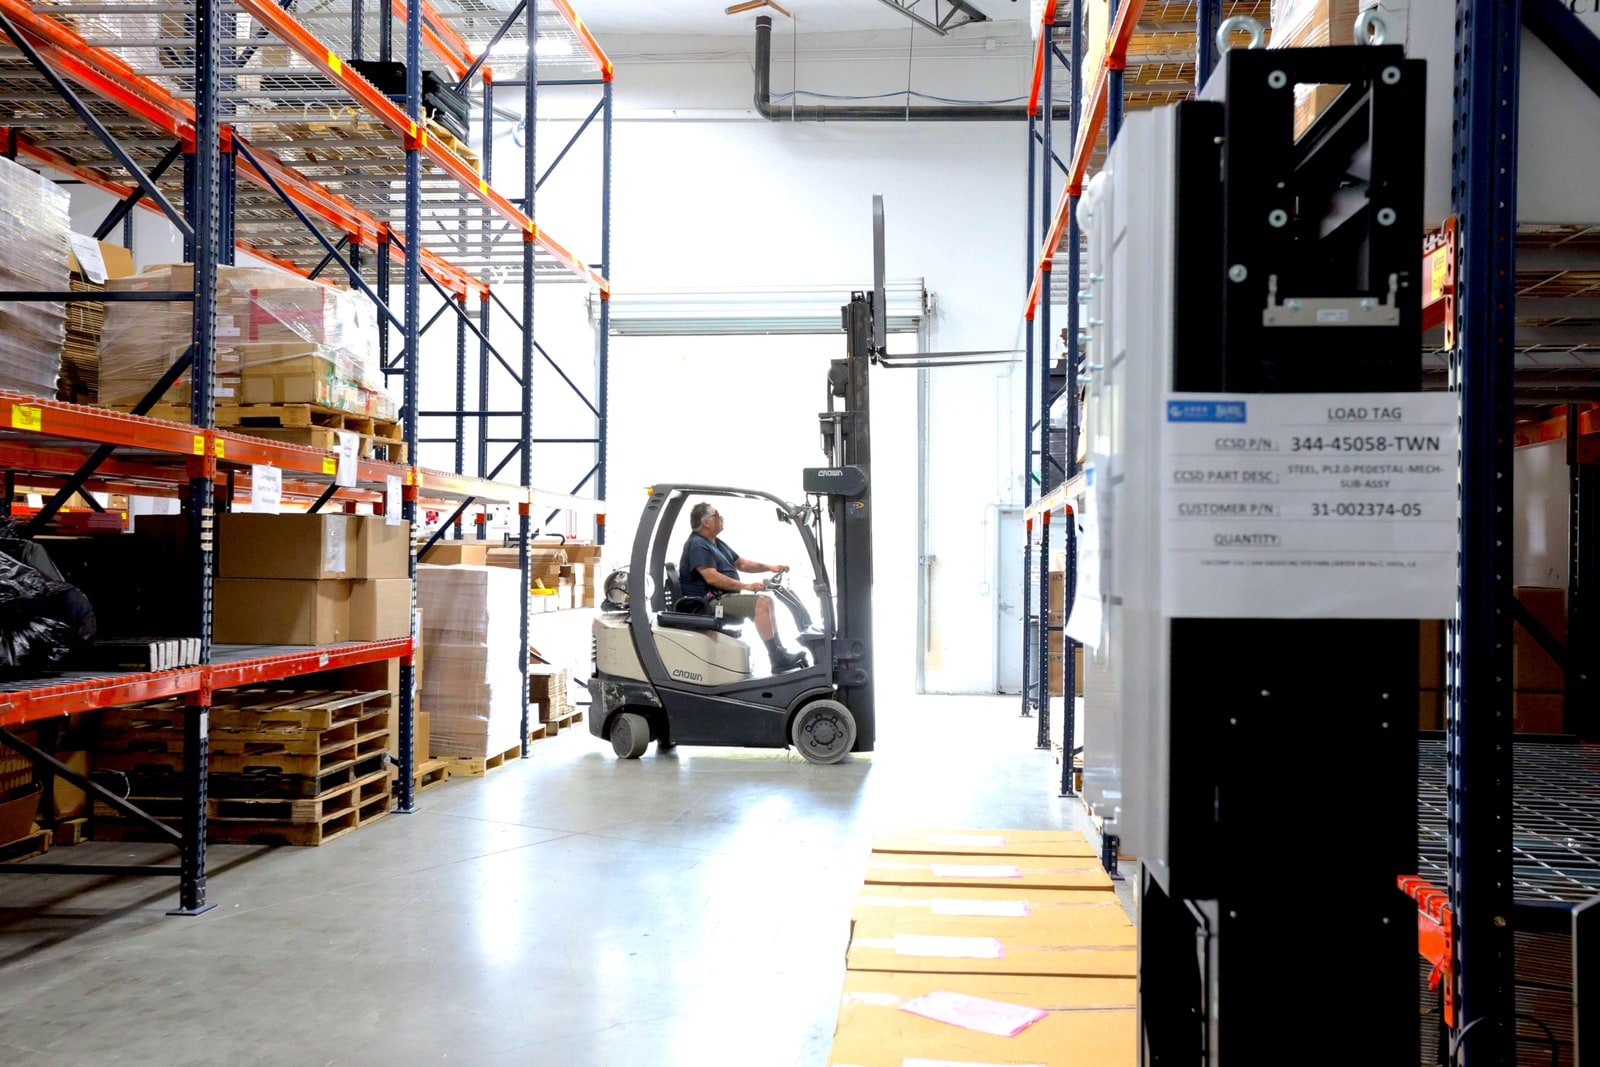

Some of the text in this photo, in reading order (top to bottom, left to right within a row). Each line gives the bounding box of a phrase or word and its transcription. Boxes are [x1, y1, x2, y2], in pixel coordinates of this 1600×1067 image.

[1328, 407, 1402, 419] LOAD TAG
[1215, 438, 1246, 450] CCSD
[1291, 436, 1440, 451] 344-45058-TWN
[1288, 464, 1319, 475] STEEL,
[1174, 470, 1205, 482] CCSD
[1207, 471, 1239, 481] PART
[1340, 479, 1391, 489] SUB-ASSY
[1178, 503, 1247, 514] CUSTOMER
[1312, 503, 1422, 516] 31-002374-05
[672, 669, 703, 681] CROWN
